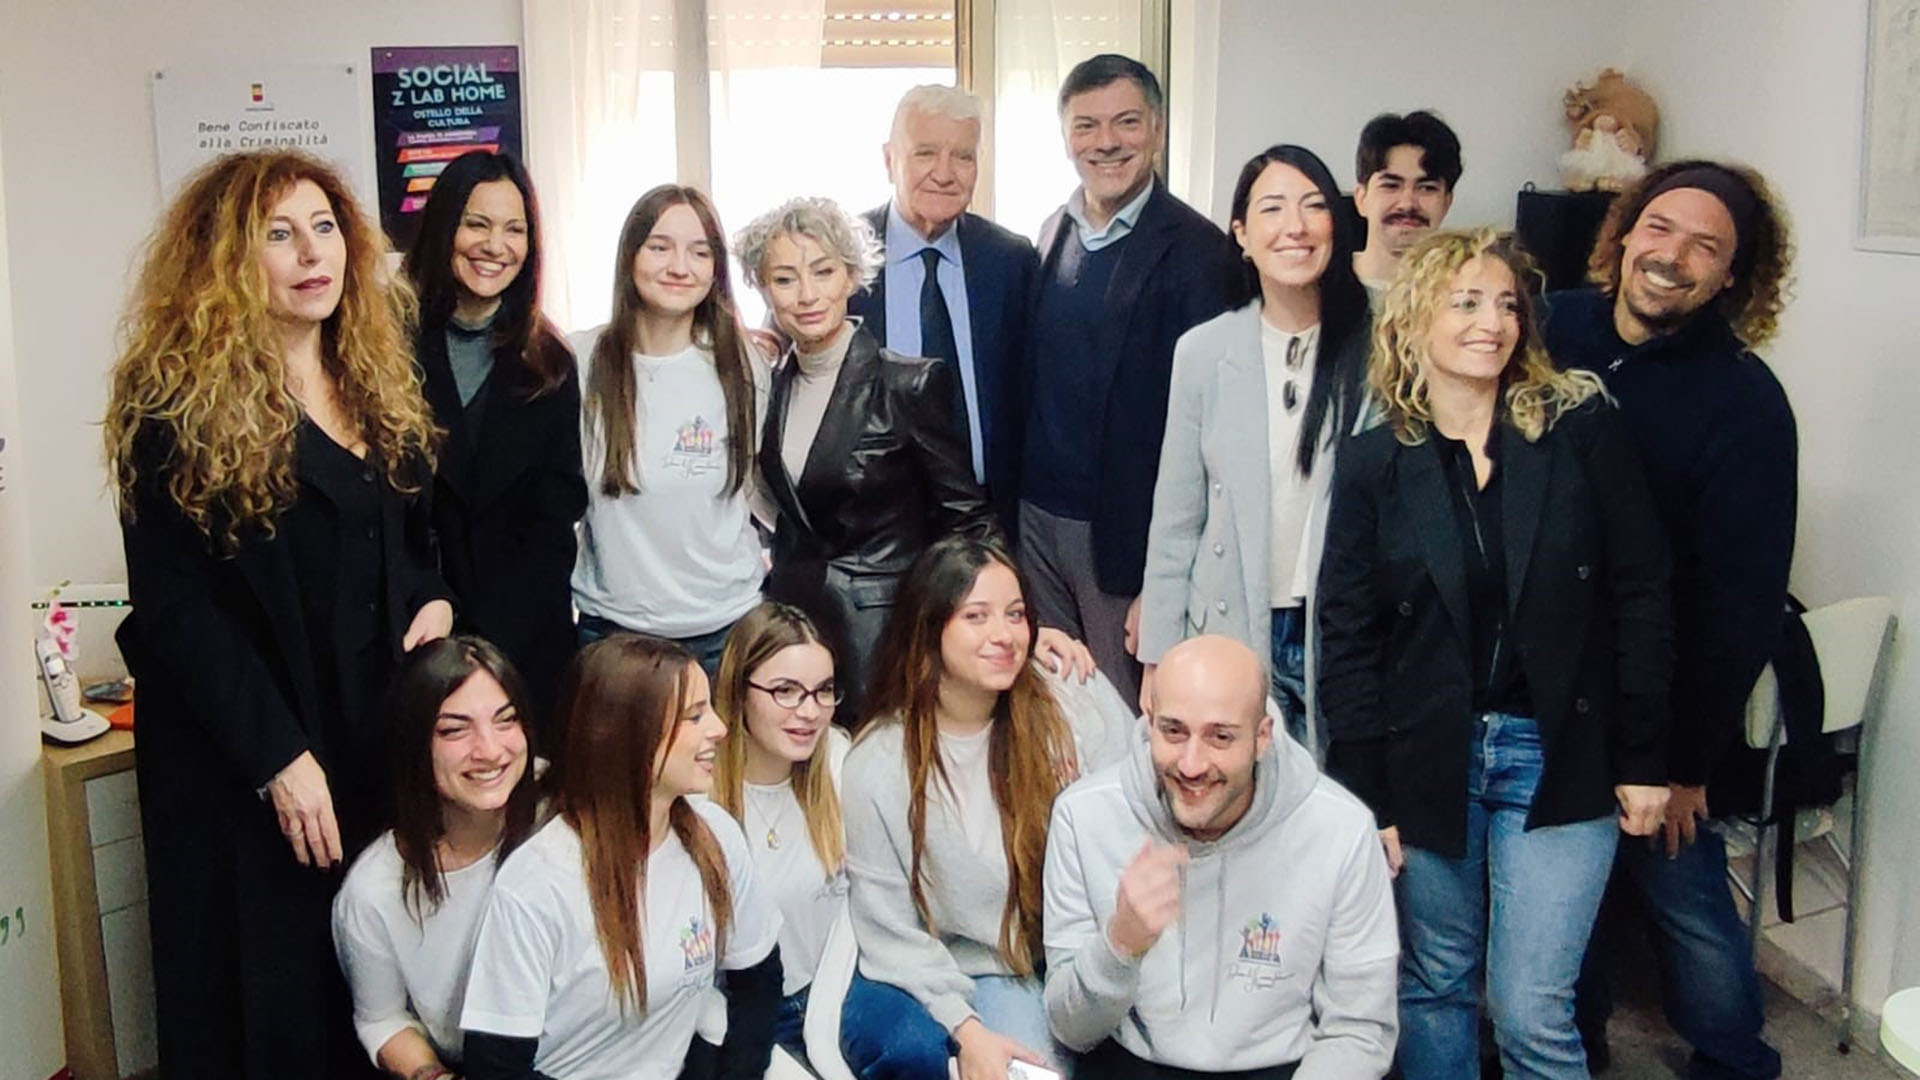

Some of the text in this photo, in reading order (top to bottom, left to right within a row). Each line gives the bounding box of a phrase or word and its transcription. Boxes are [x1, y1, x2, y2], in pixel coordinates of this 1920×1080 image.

[398, 62, 495, 88] SOCIAL
[391, 84, 506, 106] Z LAB HOME
[413, 106, 483, 119] OSTELLO DELLA
[198, 120, 320, 133] Bene Confiscato
[427, 118, 471, 127] CULTURA
[199, 134, 328, 148] alla Criminalità
